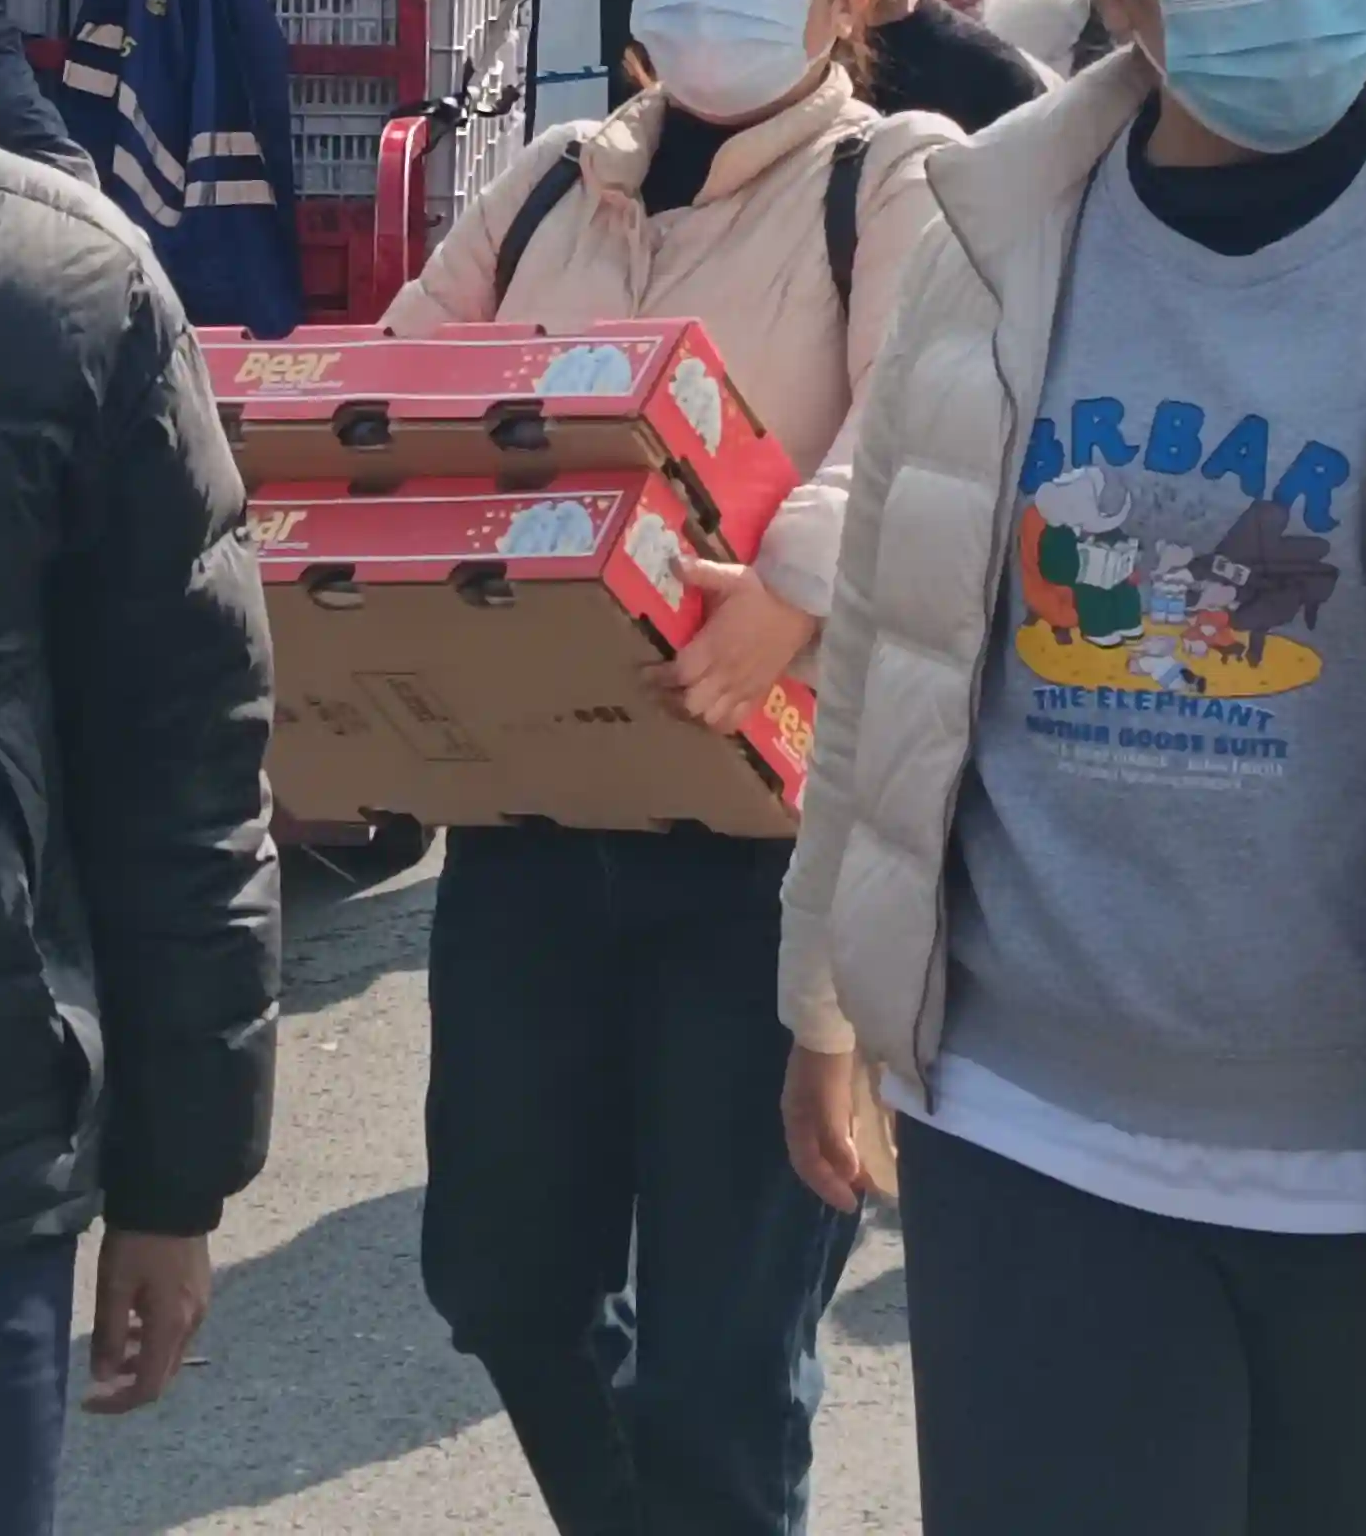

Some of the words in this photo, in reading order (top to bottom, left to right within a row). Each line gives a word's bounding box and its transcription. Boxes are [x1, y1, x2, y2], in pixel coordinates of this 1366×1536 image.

[234, 352, 342, 383] Bear
[1033, 685, 1086, 711] THE
[1096, 685, 1277, 734] ELEPHANT
[1118, 727, 1205, 752] GOOSE
